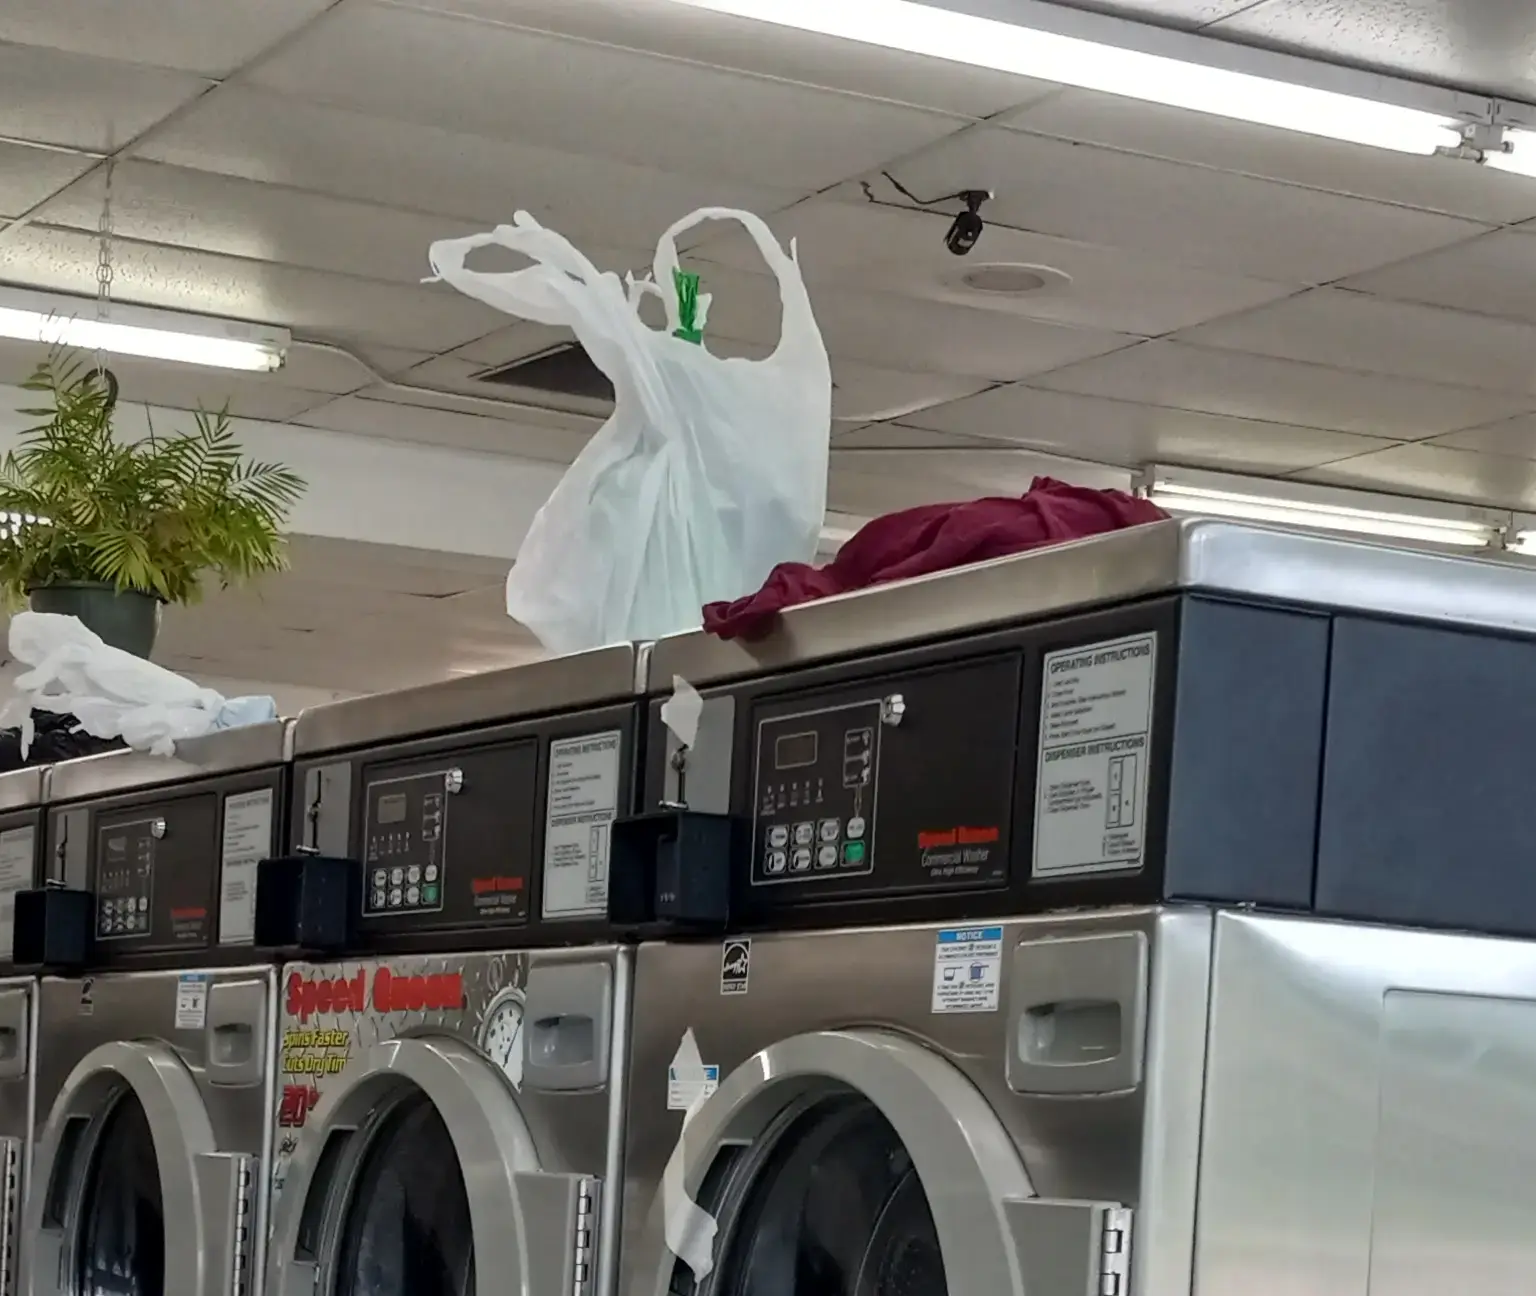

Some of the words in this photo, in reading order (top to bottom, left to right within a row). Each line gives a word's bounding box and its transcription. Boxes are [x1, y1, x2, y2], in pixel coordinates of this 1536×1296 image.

[956, 930, 983, 940] NOTICE
[312, 1028, 350, 1048] Faster
[306, 1054, 327, 1078] Dry
